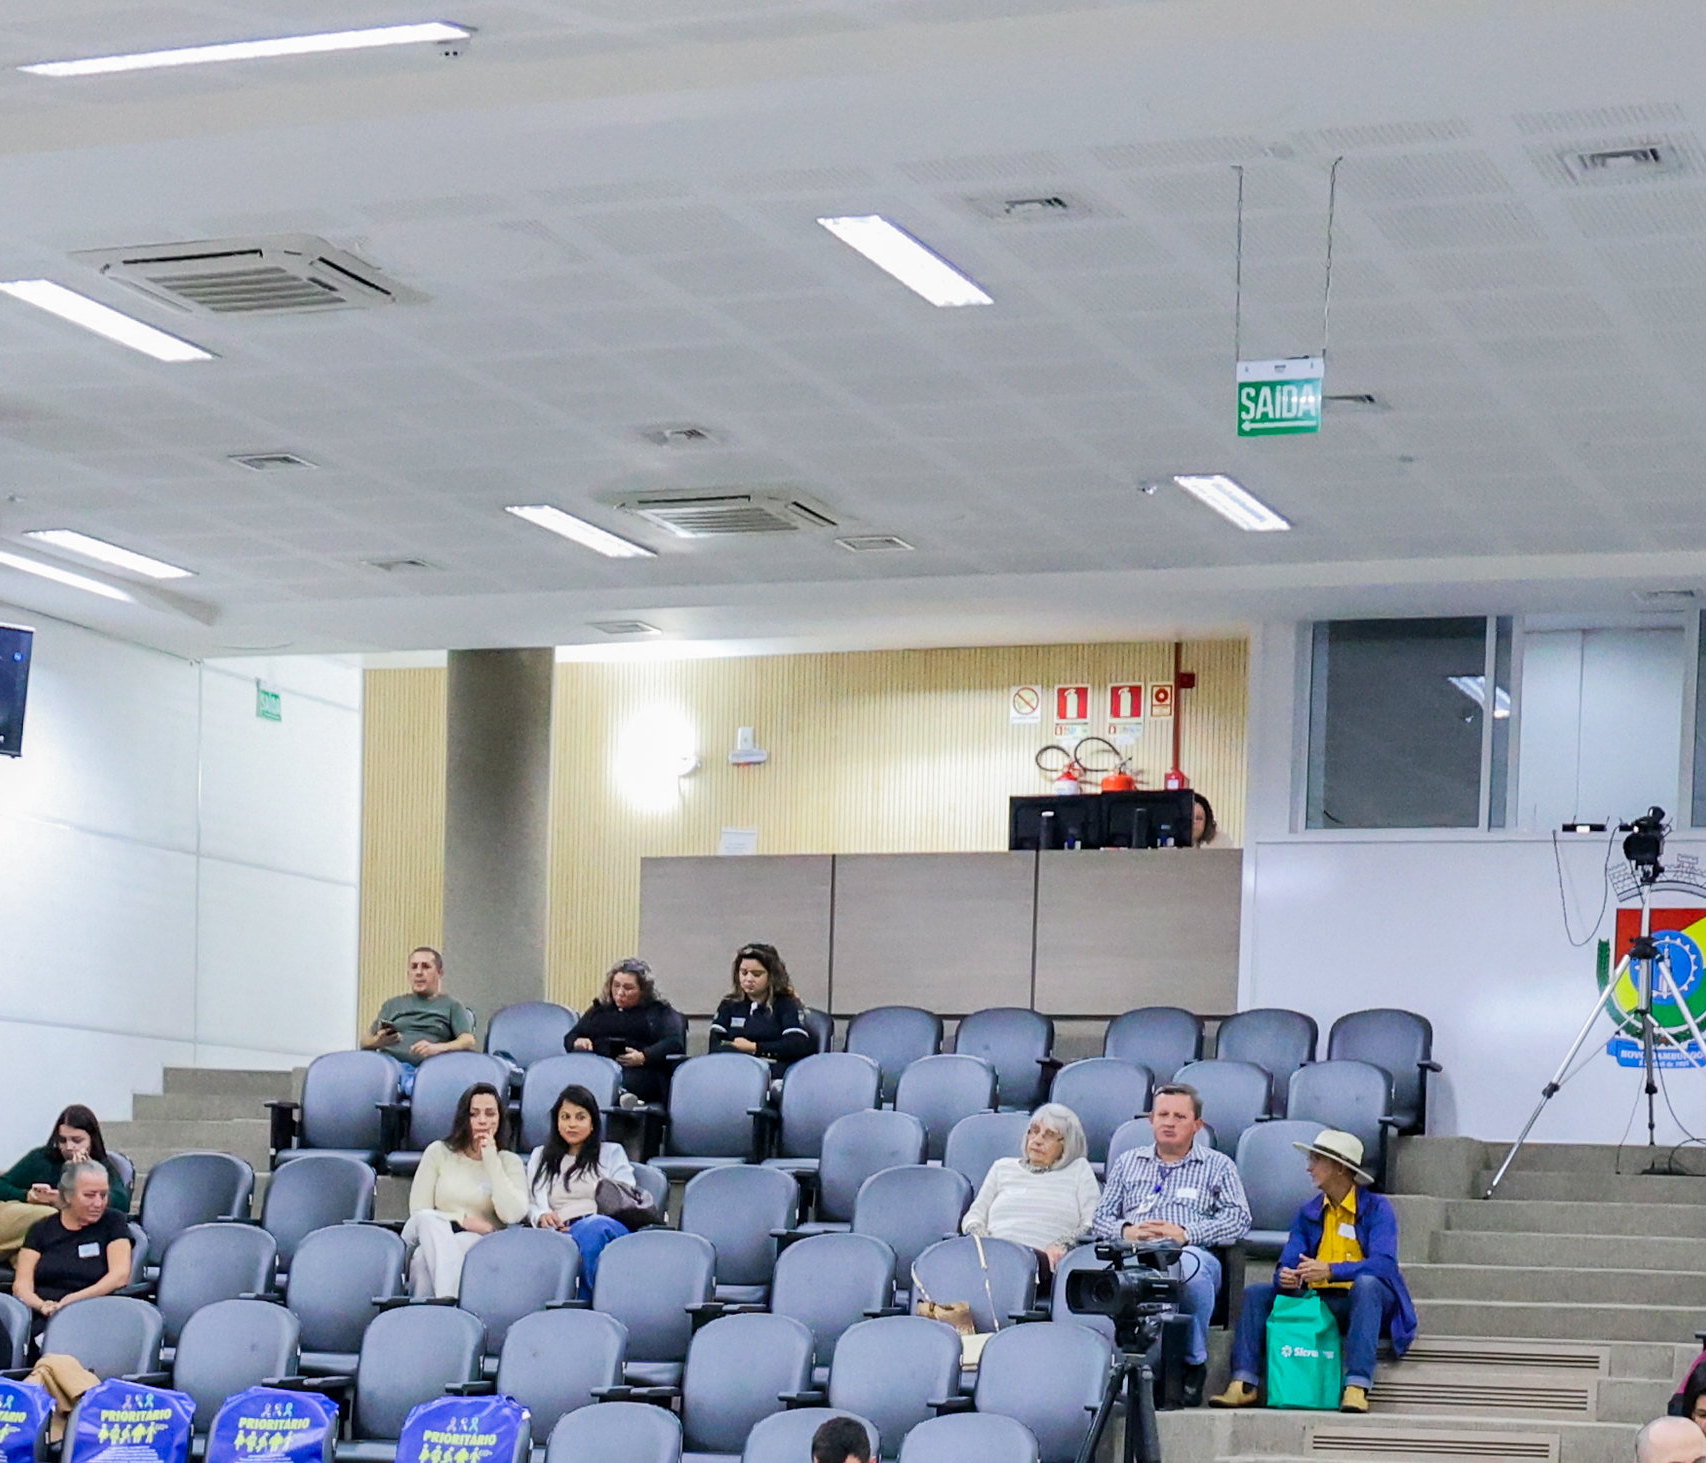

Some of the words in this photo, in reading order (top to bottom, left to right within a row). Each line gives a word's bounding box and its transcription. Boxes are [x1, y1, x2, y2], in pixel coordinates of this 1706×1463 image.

[1241, 384, 1315, 419] SAÍDA
[100, 1408, 173, 1423] PRIORITÁRIO
[238, 1416, 311, 1431] PRIORITÁRIO
[423, 1430, 498, 1446] PRIORITÁRIO
